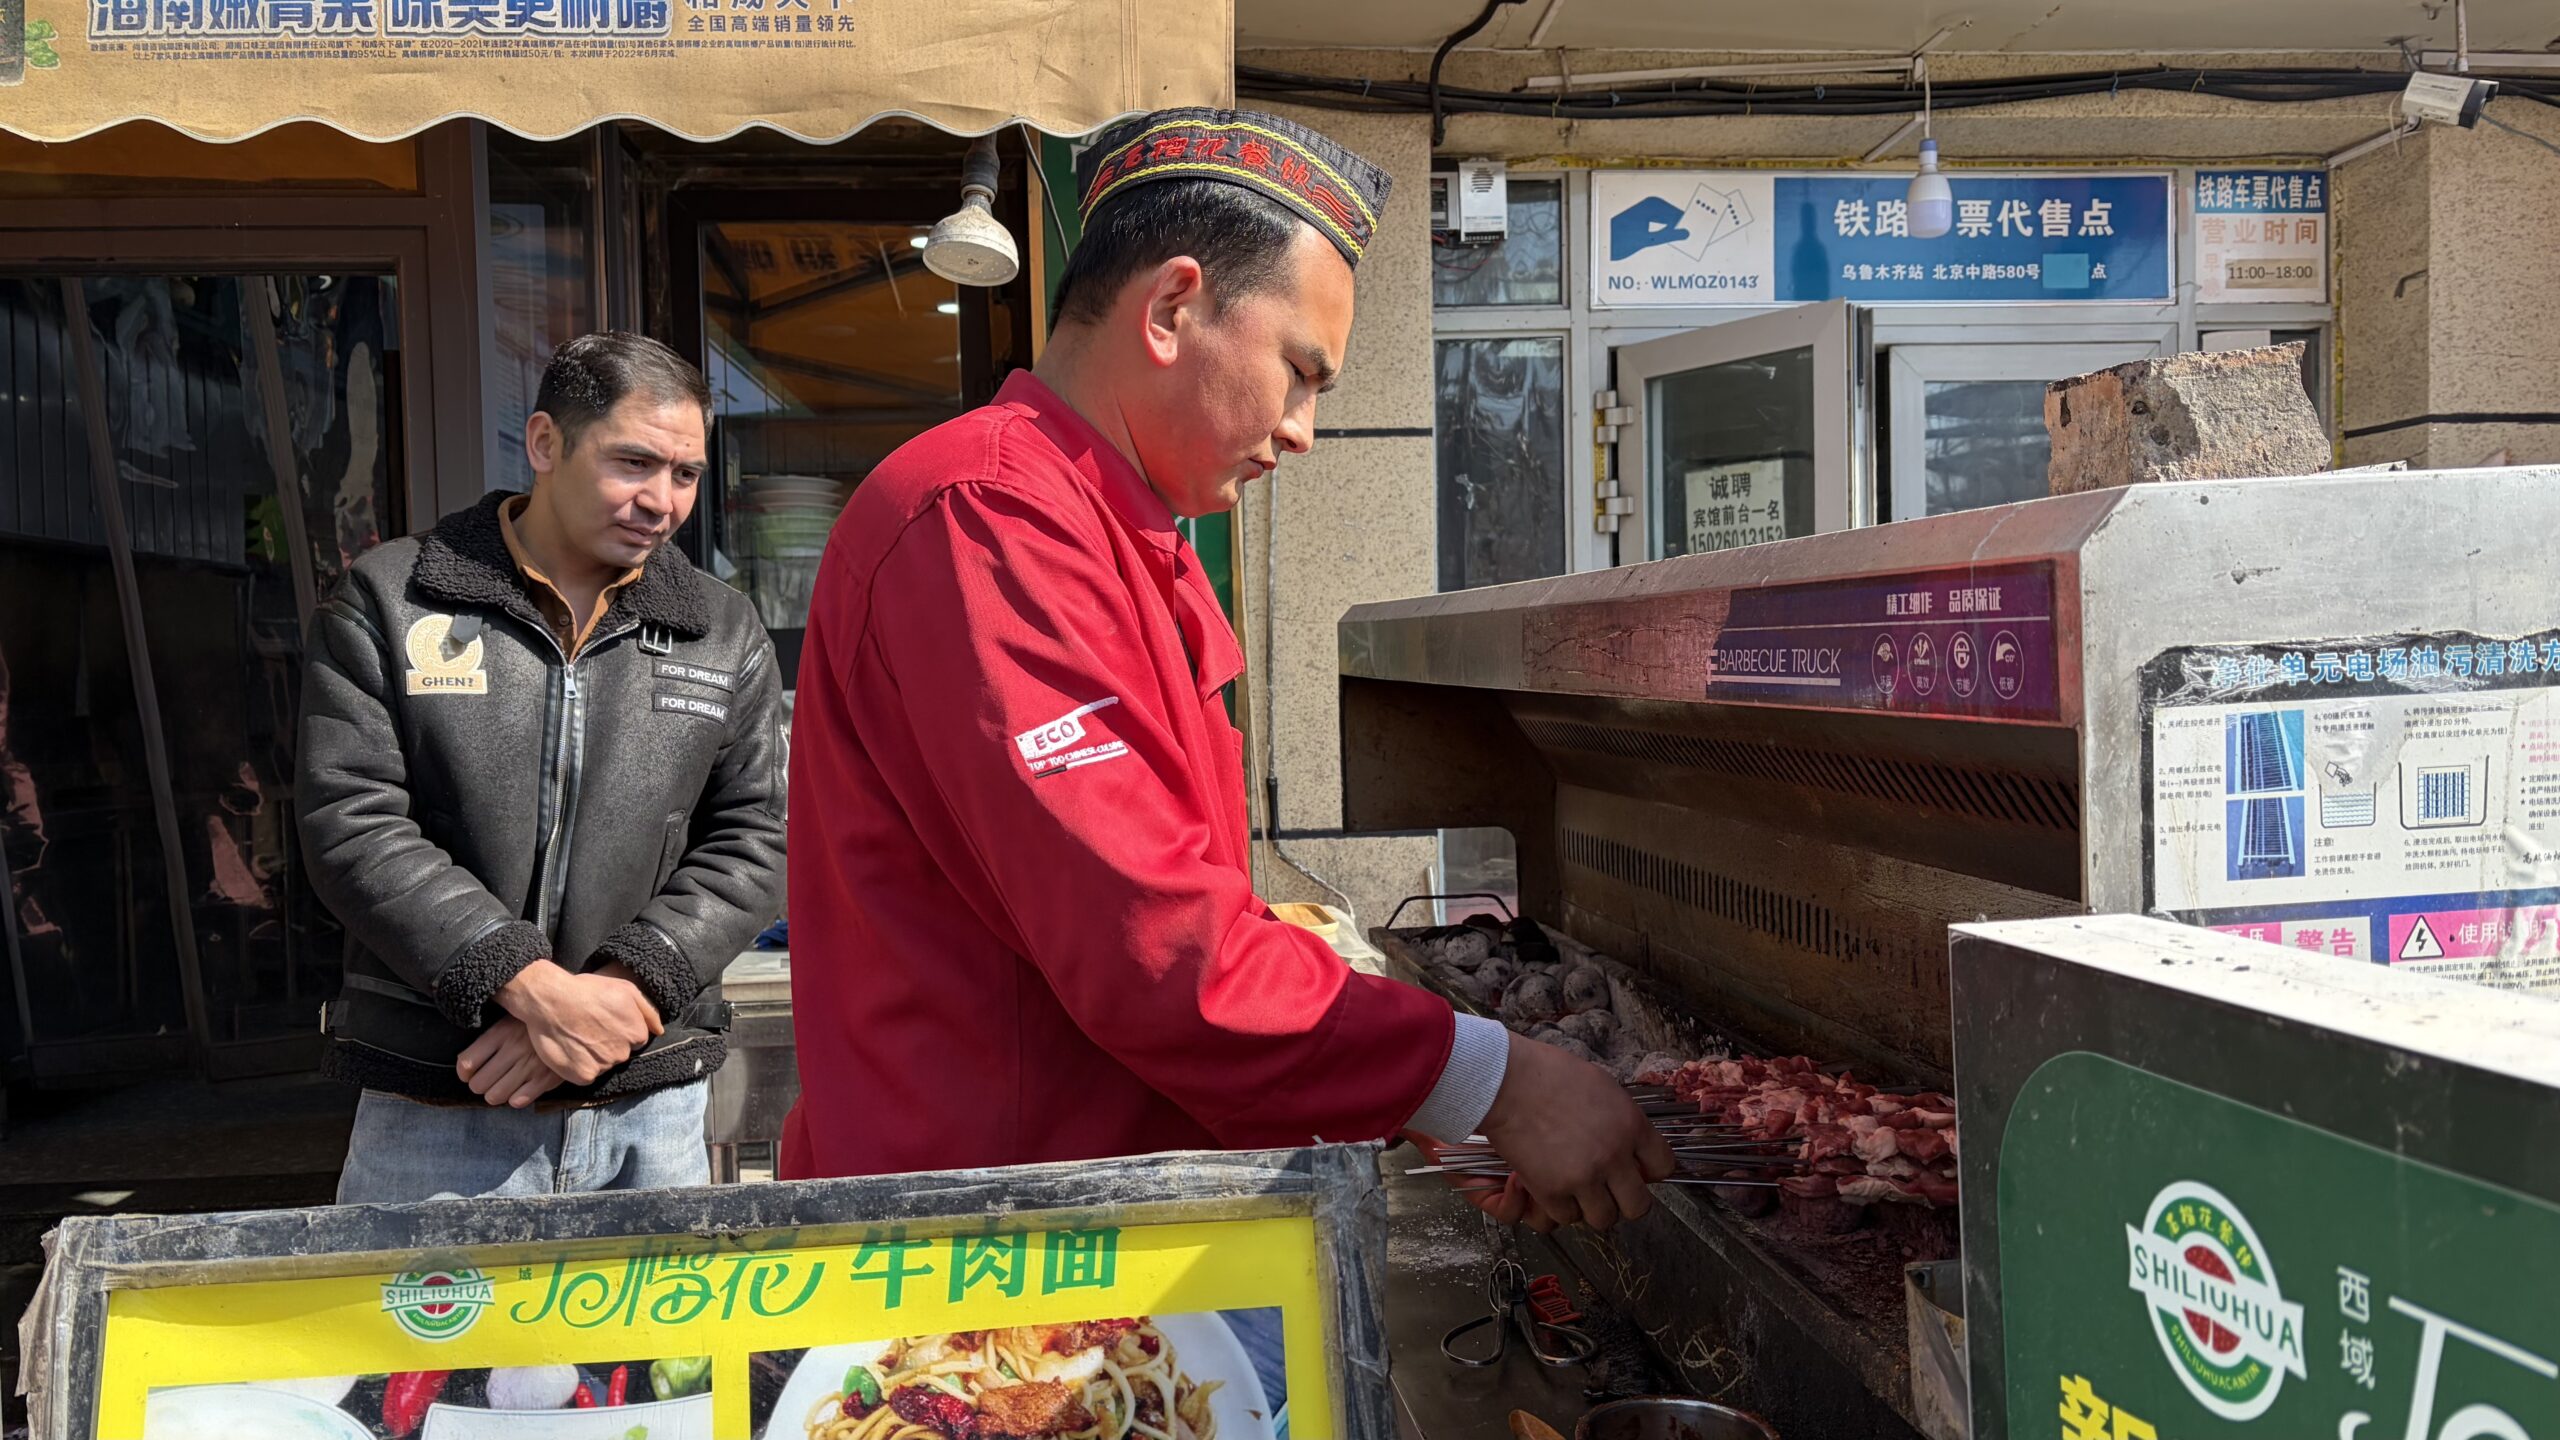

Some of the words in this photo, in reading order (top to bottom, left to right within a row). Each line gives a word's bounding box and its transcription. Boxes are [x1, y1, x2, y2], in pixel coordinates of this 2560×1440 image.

[687, 14, 855, 33] 全国高端销量领先
[2198, 175, 2322, 209] 铁路车票代售点
[1834, 199, 2115, 238] 铁路票代售点
[2202, 218, 2318, 245] 营业时间
[1842, 264, 1924, 280] 乌鲁木齐站
[1932, 263, 2040, 280] 北京中路580号
[2091, 262, 2108, 280] 点
[1709, 472, 1752, 500] 诚聘
[1693, 499, 1780, 528] 宾馆前台一名
[1886, 592, 1933, 616] 精工细作
[1949, 587, 2002, 613] 品质保证
[662, 664, 685, 676] FOR
[688, 668, 728, 686] DREAM
[1720, 649, 1787, 673] BARBECUE
[1791, 648, 1842, 674] TRUCK
[1956, 678, 1971, 692] 节能
[662, 697, 685, 709] FOR
[688, 701, 724, 719] DREAM
[1034, 720, 1075, 750] ECO
[2295, 927, 2356, 957] 警告
[850, 1220, 1122, 1310] 牛肉面
[386, 1284, 491, 1304] SHILIUHUA
[2134, 1244, 2298, 1359] SHILIUHUA
[2337, 1265, 2375, 1390] 西域
